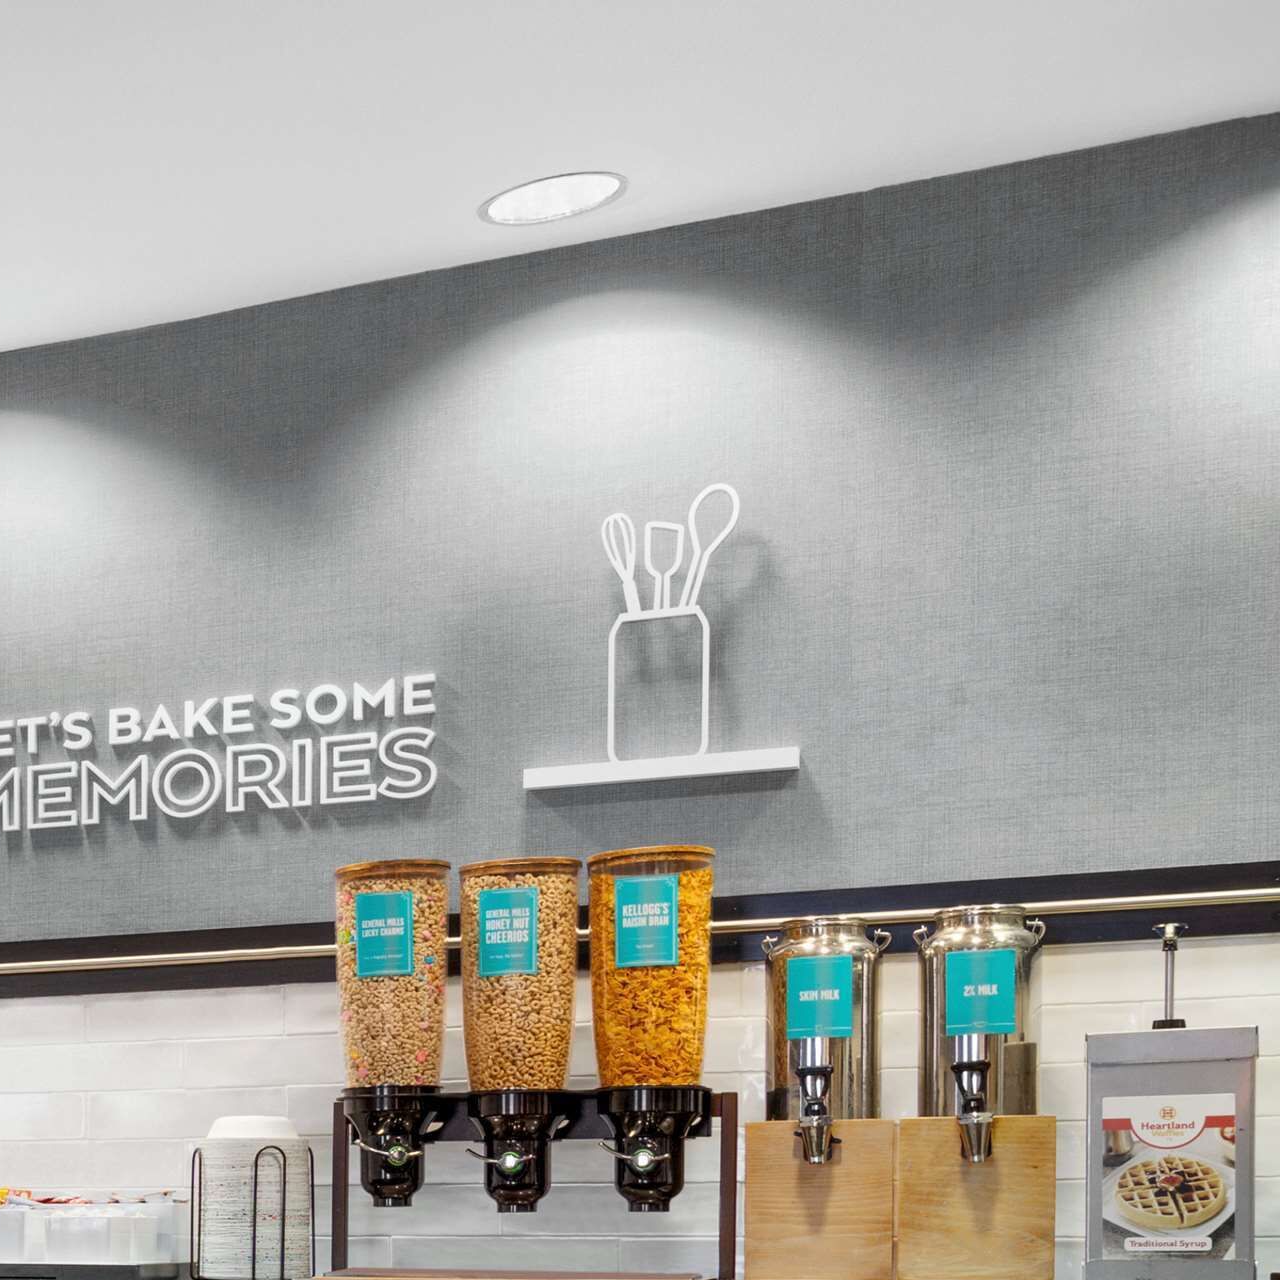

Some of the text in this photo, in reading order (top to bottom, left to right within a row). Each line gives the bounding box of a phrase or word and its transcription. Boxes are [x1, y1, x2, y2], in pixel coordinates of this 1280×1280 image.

[107, 694, 255, 745] BAKE
[269, 673, 437, 729] SOME
[485, 907, 530, 919] GENERAL MILLS
[362, 917, 404, 929] GENERAL MILLS
[485, 917, 529, 931] HONEY NUT
[622, 914, 670, 928] RAISIN BRAN
[362, 926, 405, 938] LUCKY CHARMS
[485, 929, 529, 945] CHEERIOS
[799, 988, 840, 1001] SKIM MILK
[963, 983, 999, 997] 2% MILK
[1140, 1120, 1195, 1130] Heartland
[1129, 1240, 1208, 1249] Traditional Syrup
